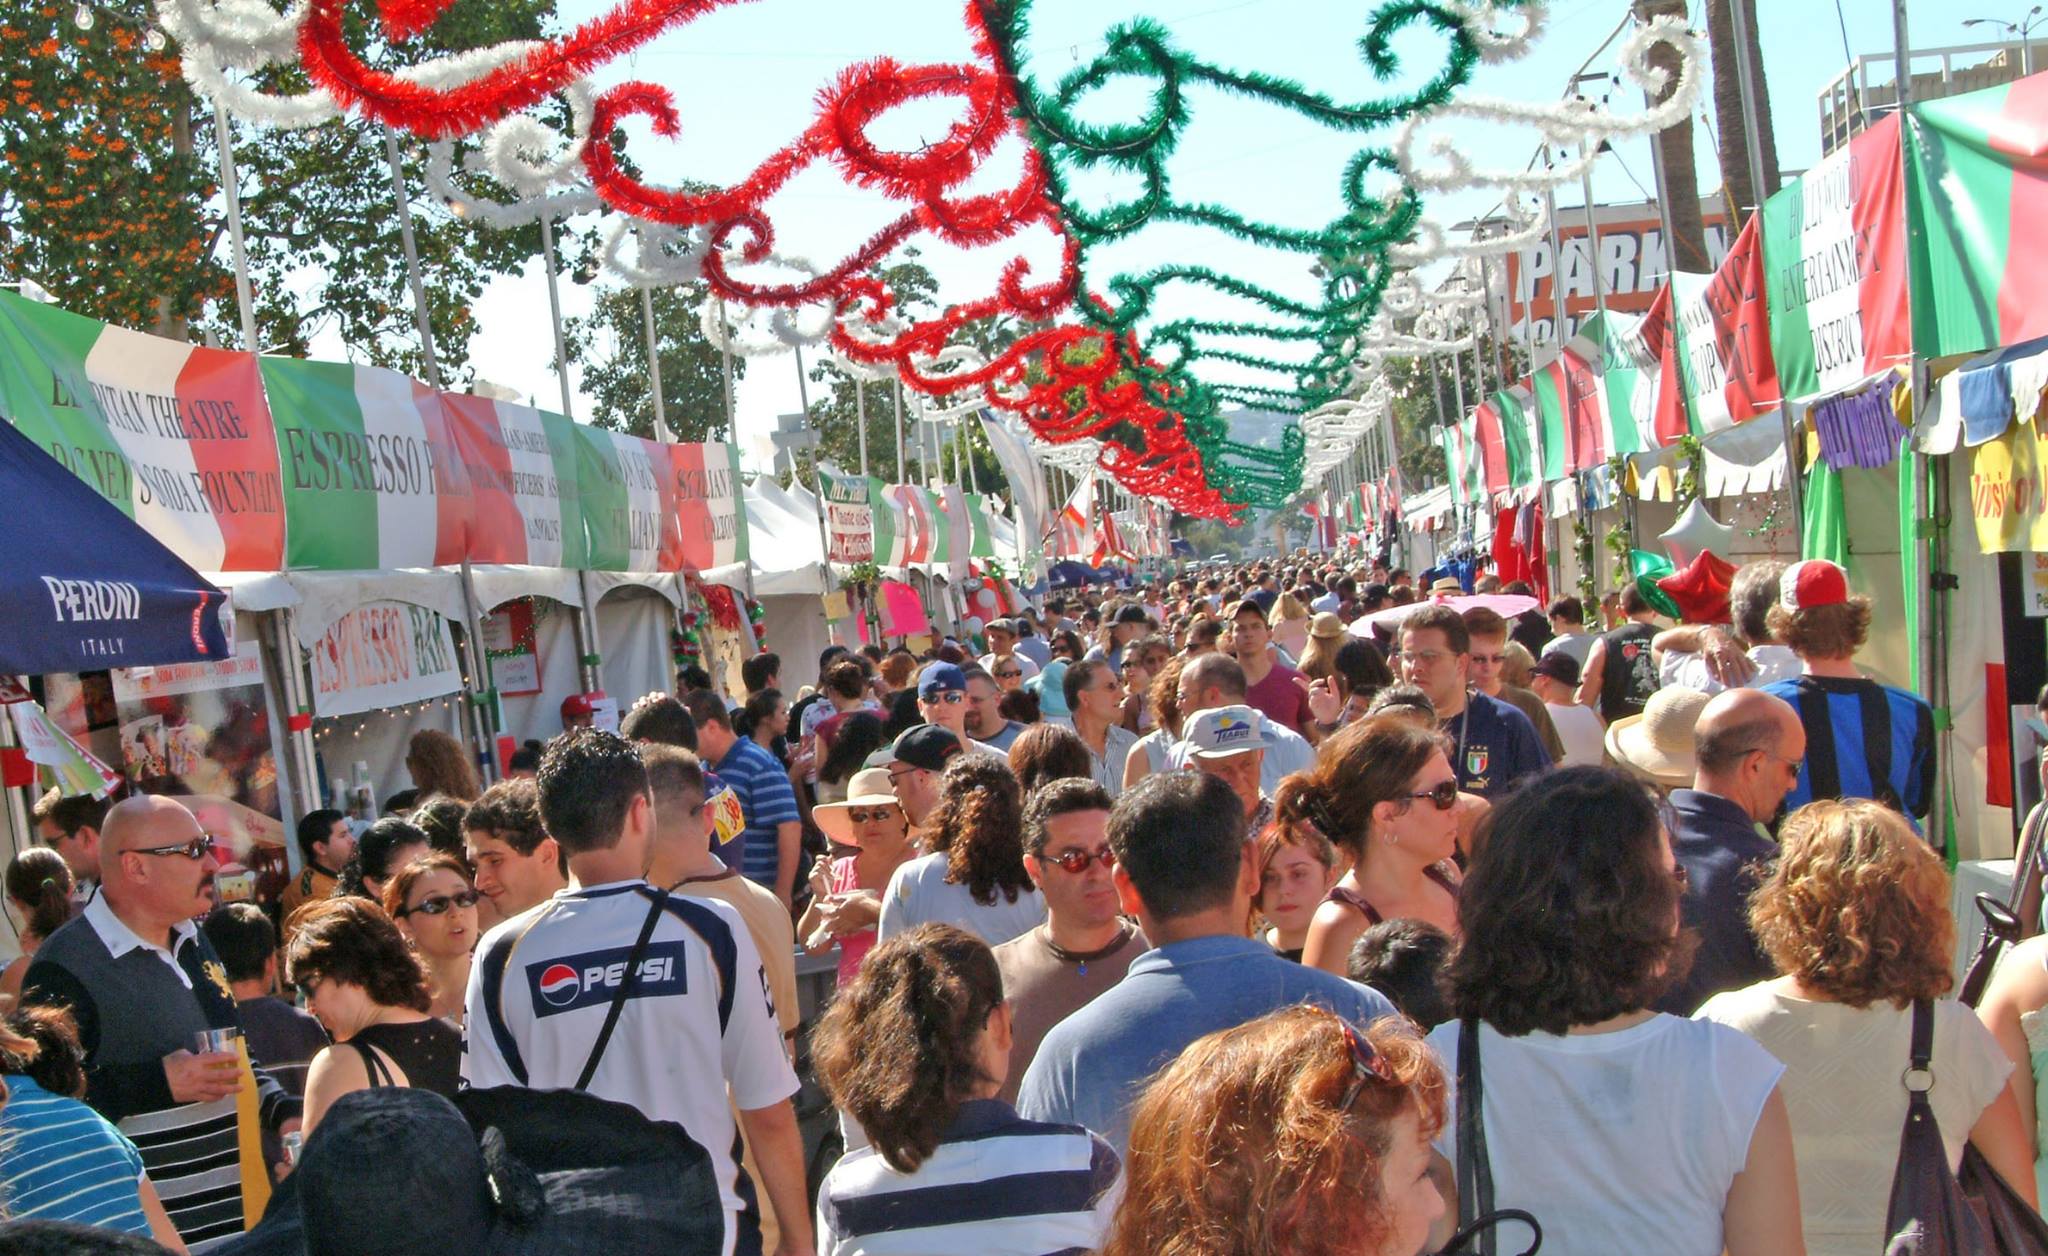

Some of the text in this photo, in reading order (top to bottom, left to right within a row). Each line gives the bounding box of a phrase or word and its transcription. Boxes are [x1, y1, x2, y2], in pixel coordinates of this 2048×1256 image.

[1809, 310, 1865, 373] DISTRICT
[147, 394, 248, 440] THEATRE
[284, 428, 421, 495] ESPRESSO
[41, 575, 140, 622] PERONI
[81, 638, 123, 656] ITALY
[583, 957, 674, 992] PESI
